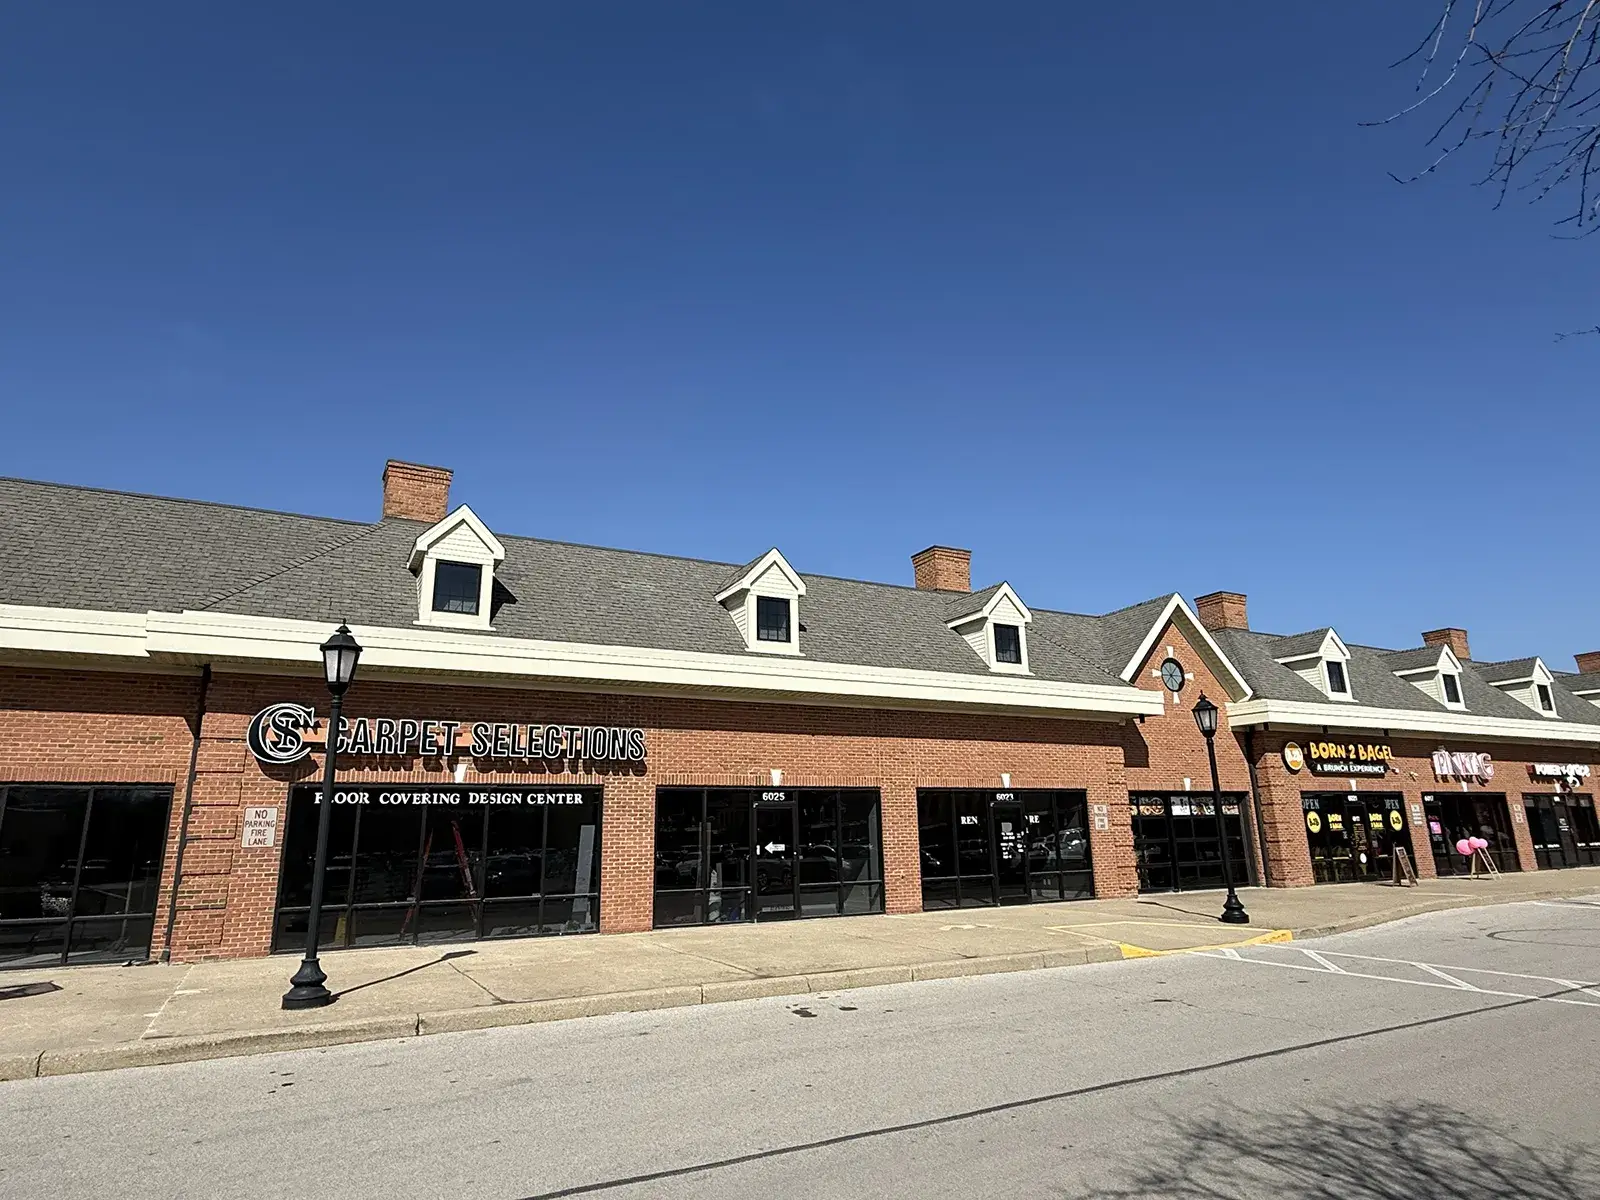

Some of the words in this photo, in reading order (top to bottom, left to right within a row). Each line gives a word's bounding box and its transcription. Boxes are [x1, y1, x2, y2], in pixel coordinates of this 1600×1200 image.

[325, 715, 460, 756] CARPET
[470, 721, 647, 762] SELECTIONS
[1310, 741, 1346, 759] BORN
[1349, 744, 1356, 759] 2
[1358, 744, 1396, 761] BAGEL
[1316, 763, 1322, 771] A
[1323, 763, 1349, 772] BRUNCH
[1349, 764, 1385, 774] EXPERIENCE
[314, 792, 370, 805] FOOR
[379, 792, 461, 805] COVERING
[469, 792, 523, 805] DESIGN
[527, 792, 584, 805] CENTER
[762, 792, 785, 802] 6025
[996, 793, 1014, 801] 6023
[254, 809, 268, 820] NO
[244, 820, 275, 829] PARKING
[250, 829, 267, 837] FIRE
[248, 838, 268, 846] LANE
